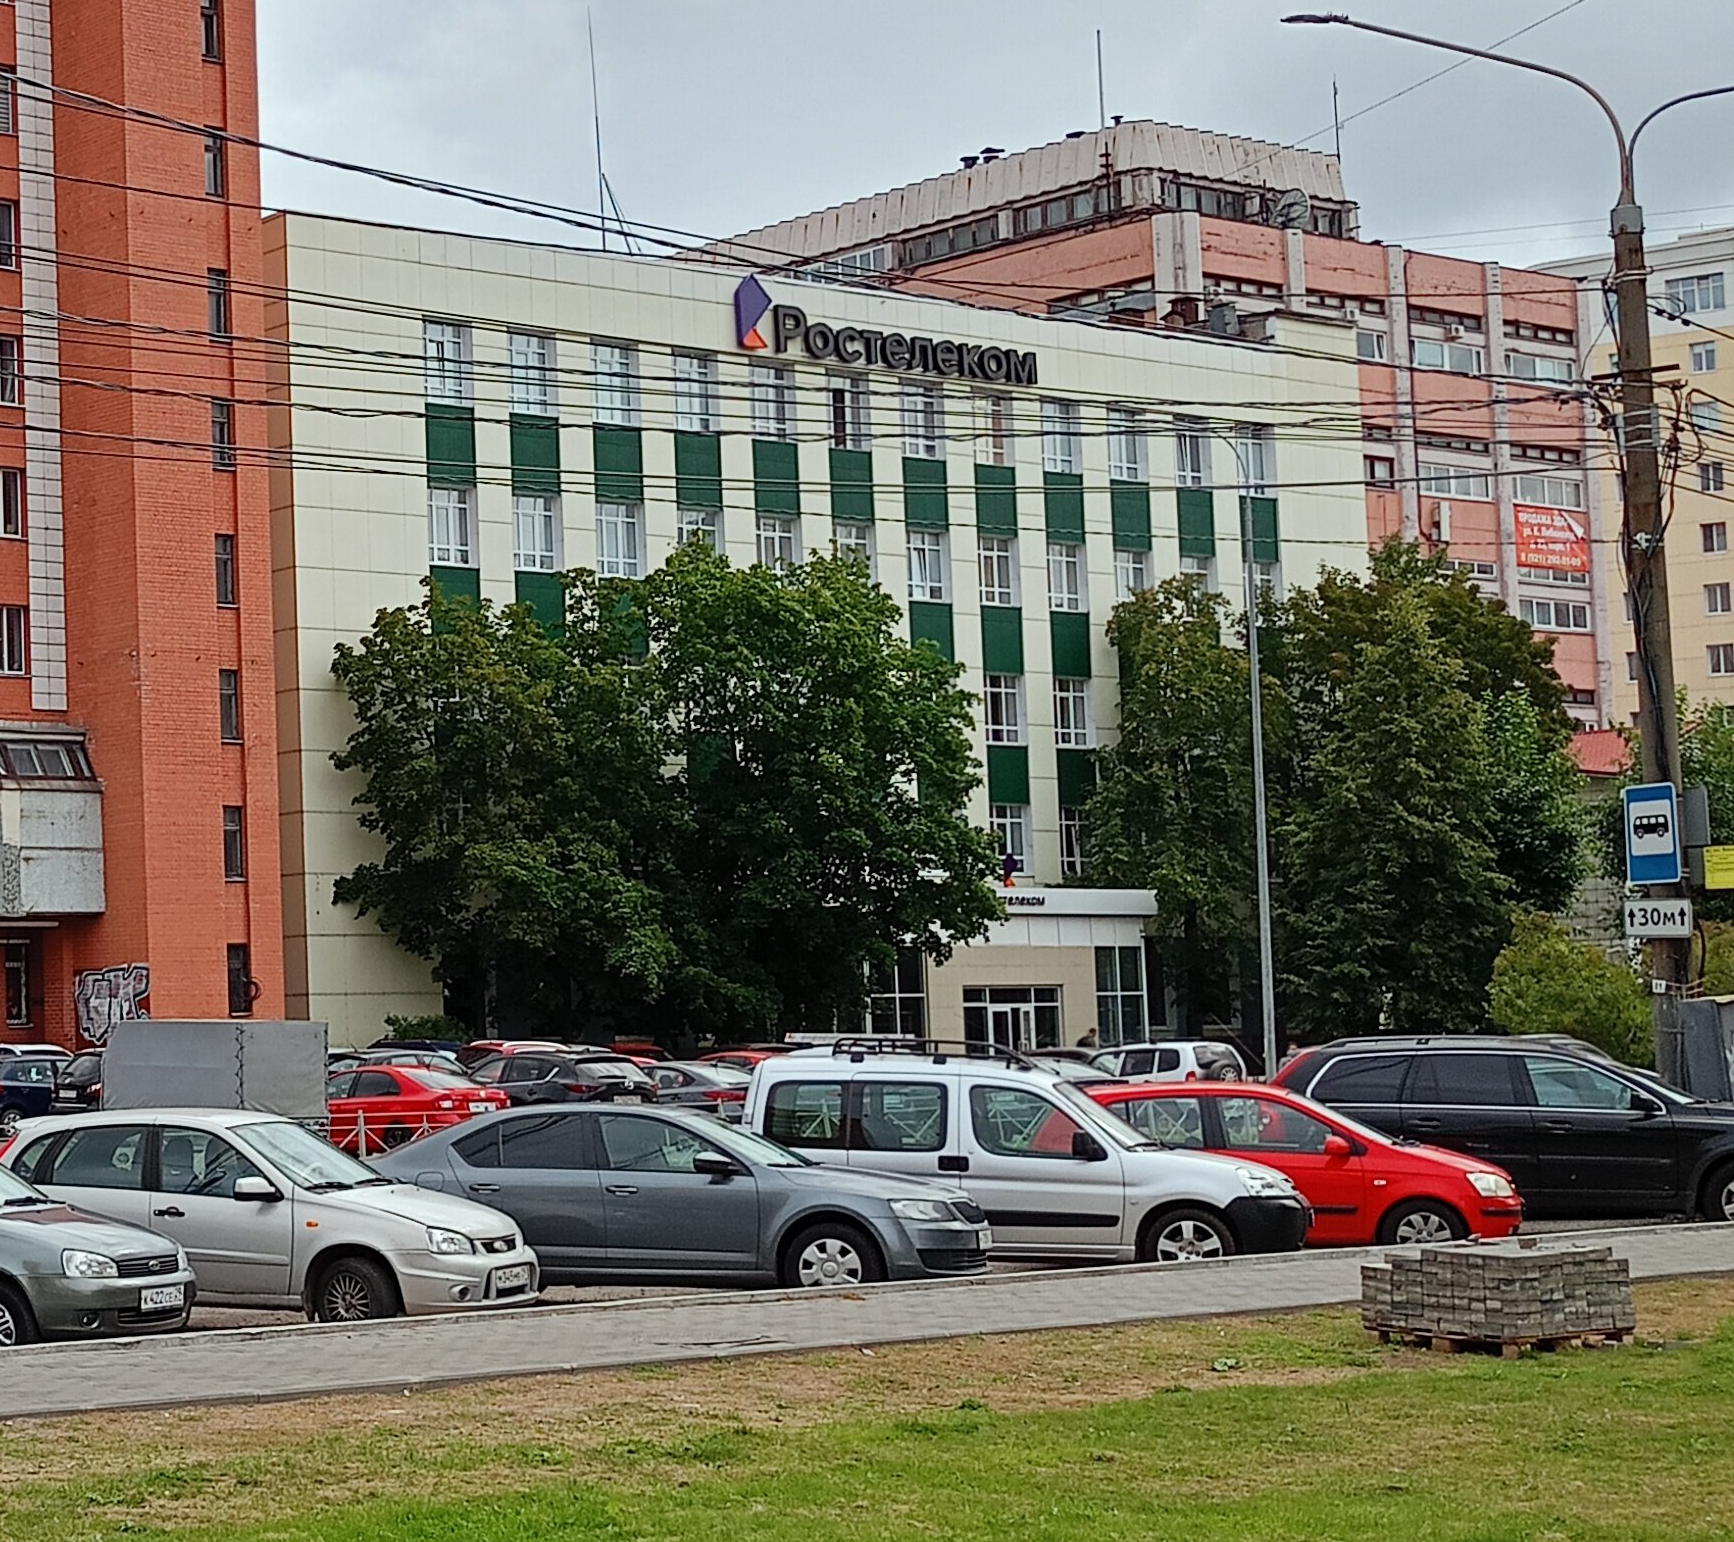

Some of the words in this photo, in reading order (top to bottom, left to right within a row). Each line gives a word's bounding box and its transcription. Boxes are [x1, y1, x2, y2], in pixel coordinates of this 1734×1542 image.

[772, 304, 1039, 386] Ростелеком
[997, 895, 1045, 907] телеком
[1638, 907, 1676, 927] 30м
